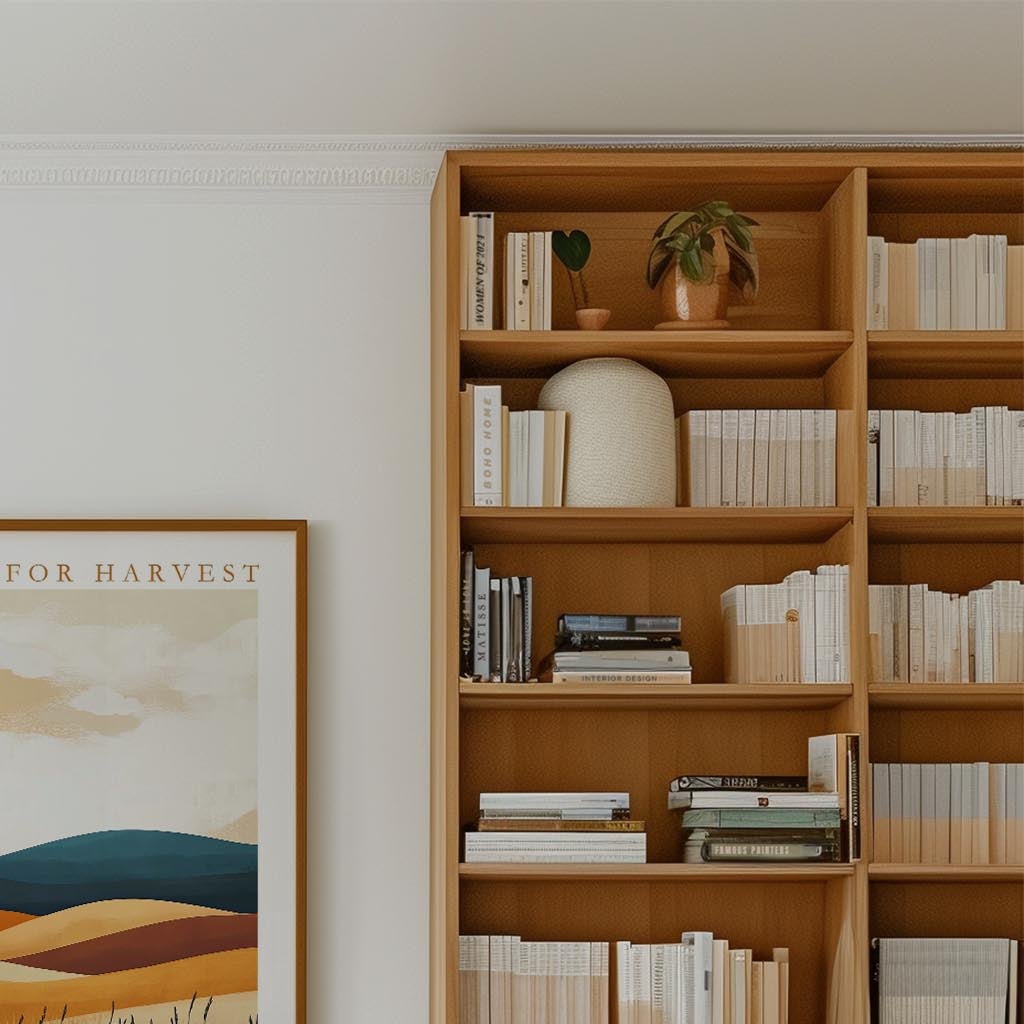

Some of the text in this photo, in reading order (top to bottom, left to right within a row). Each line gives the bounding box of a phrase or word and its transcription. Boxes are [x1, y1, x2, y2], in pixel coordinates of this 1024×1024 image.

[475, 233, 486, 324] WOMEN OF 2024
[482, 396, 493, 490] BOHO HOME
[5, 563, 74, 583] FOR
[96, 563, 261, 583] HARVEST
[476, 592, 487, 662] MATISSE
[714, 845, 789, 855] FAMOUS PAINTERS
